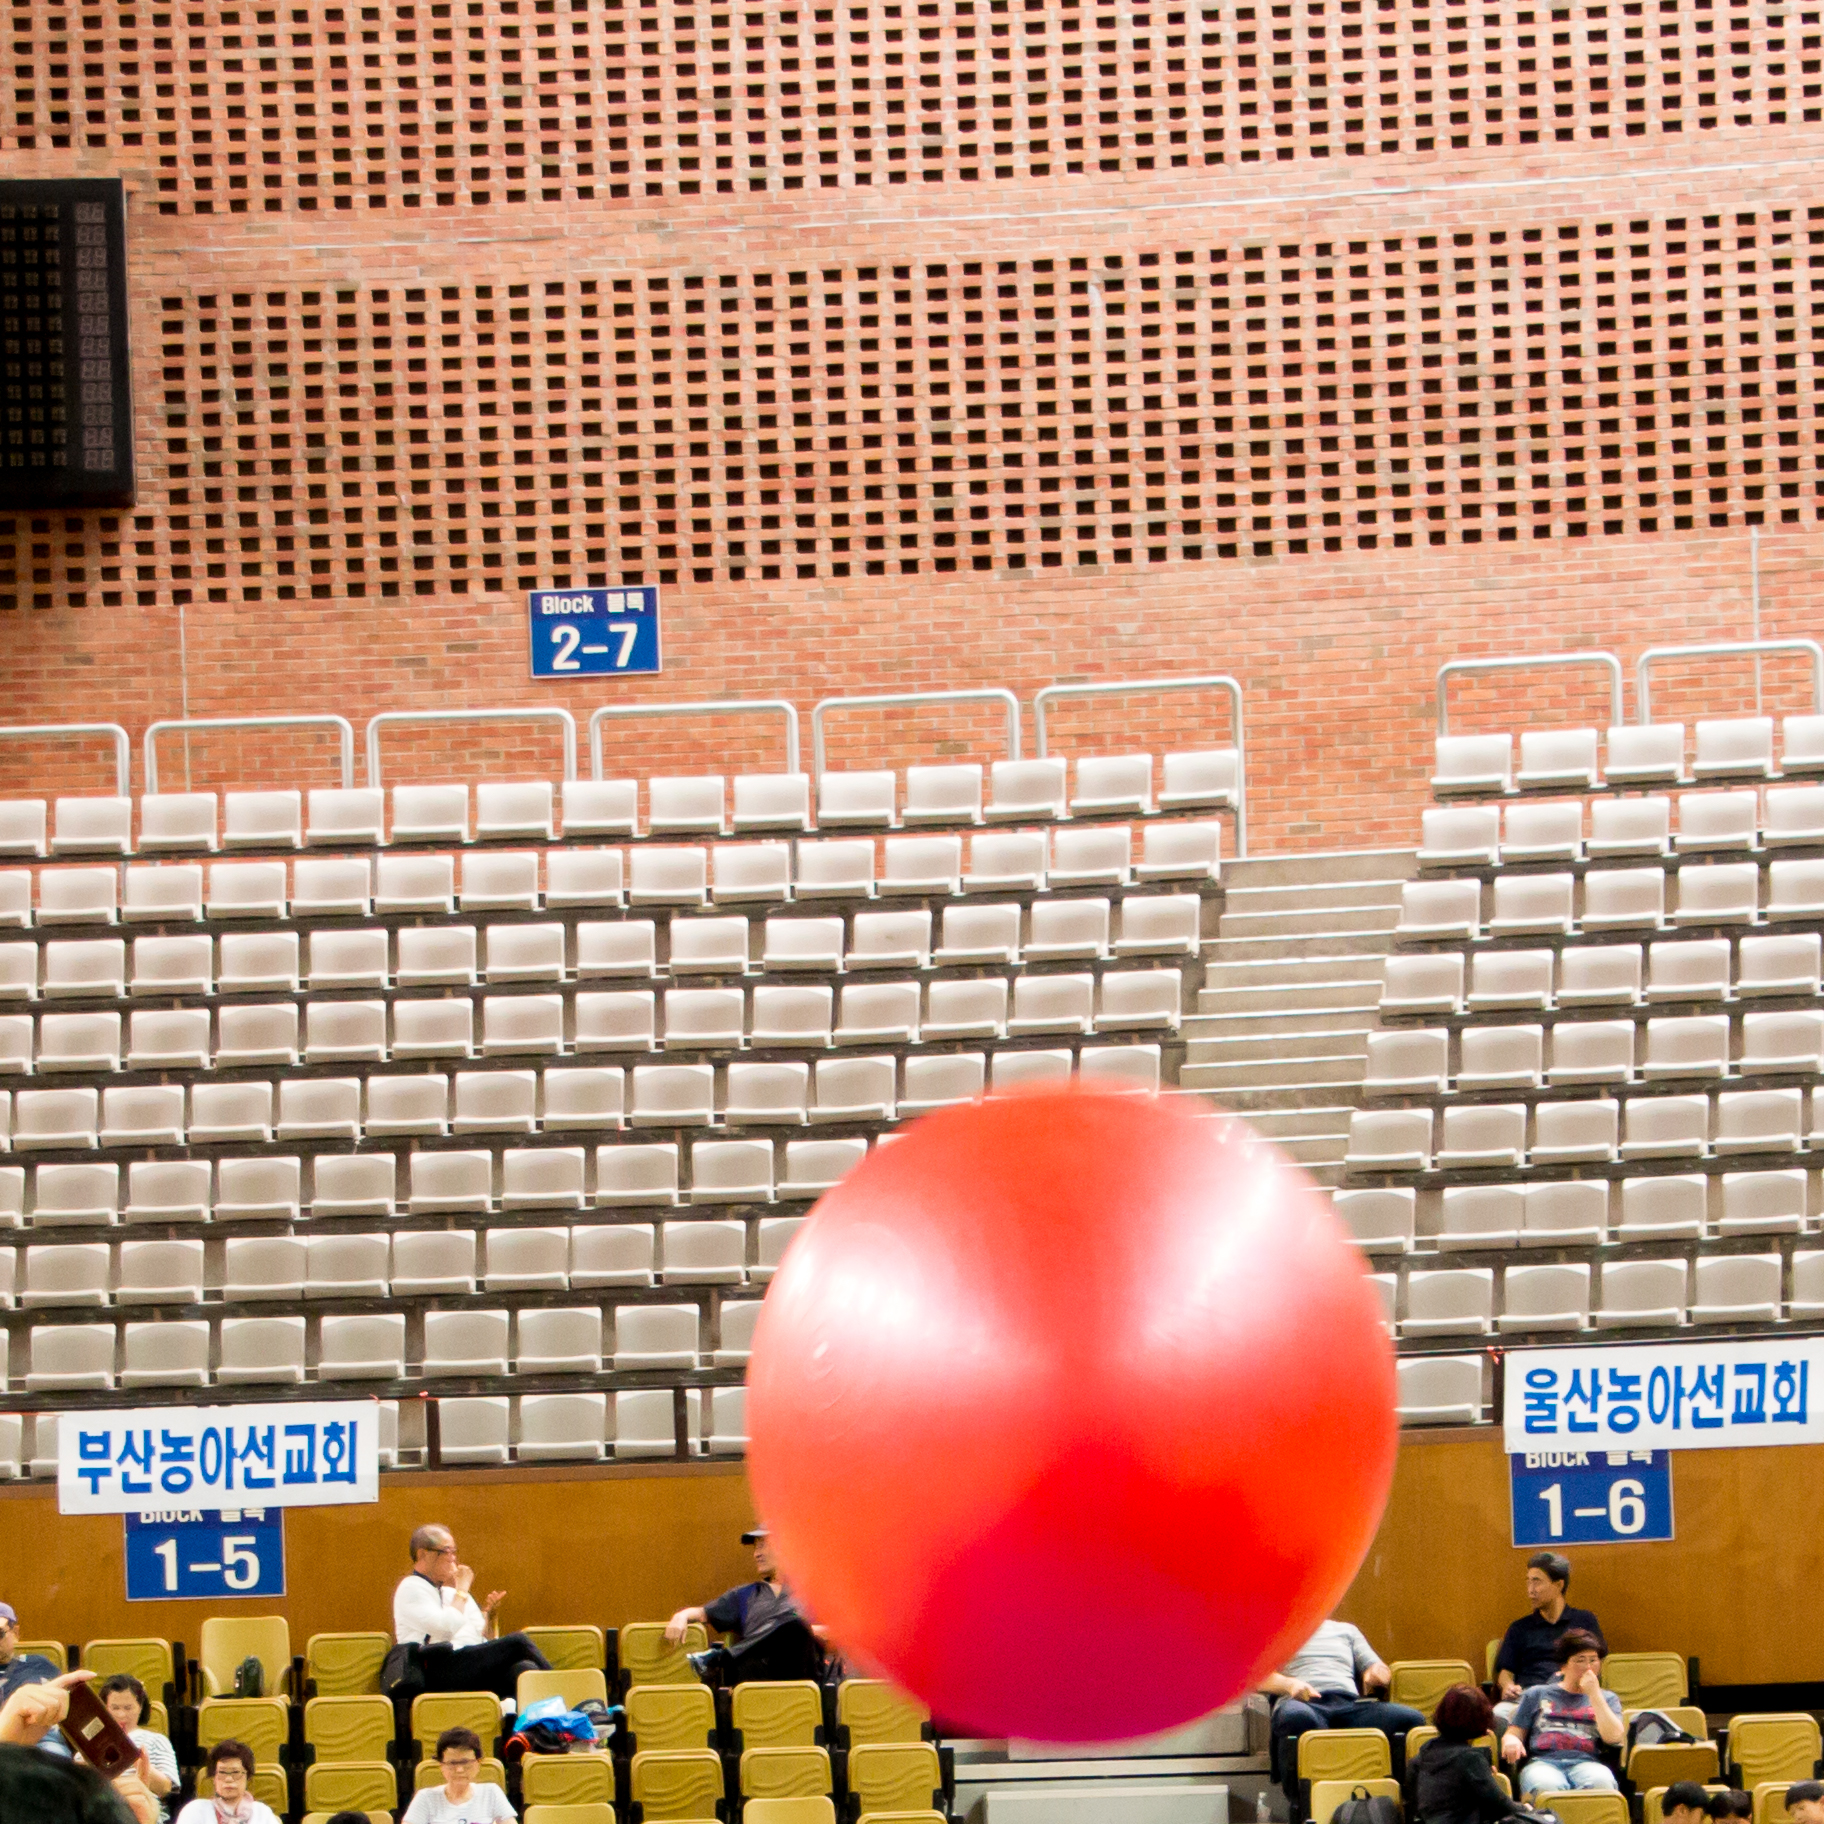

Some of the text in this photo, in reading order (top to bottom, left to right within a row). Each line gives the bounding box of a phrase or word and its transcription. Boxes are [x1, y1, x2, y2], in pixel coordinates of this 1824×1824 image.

[541, 591, 645, 615] Block 블록
[550, 623, 638, 671] 2-7
[1523, 1359, 1810, 1435] 울산농아선교회
[77, 1420, 358, 1496] 부산농아선교회
[1538, 1478, 1647, 1538] 1-6
[154, 1535, 261, 1592] 1-5
